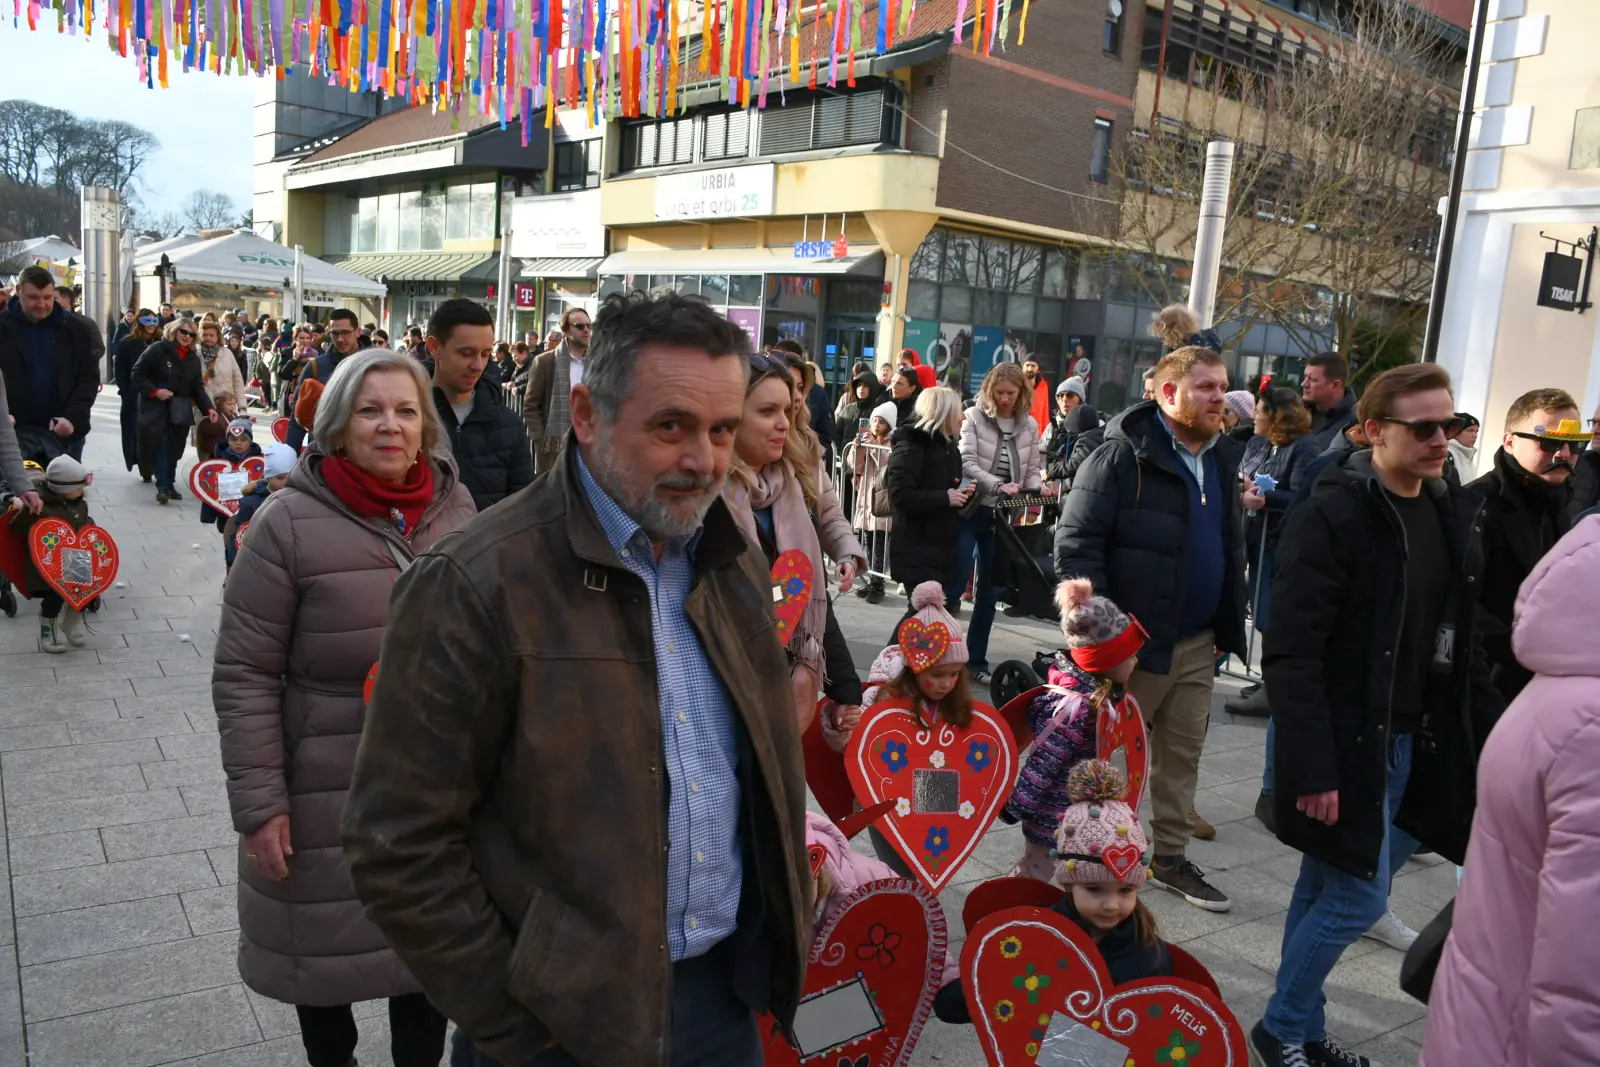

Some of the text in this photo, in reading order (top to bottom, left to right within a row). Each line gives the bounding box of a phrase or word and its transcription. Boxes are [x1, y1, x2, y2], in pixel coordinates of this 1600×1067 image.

[692, 199, 706, 214] et
[741, 193, 759, 212] 25
[794, 240, 832, 258] ERSTE
[521, 288, 533, 304] T
[1551, 286, 1575, 303] TISAK
